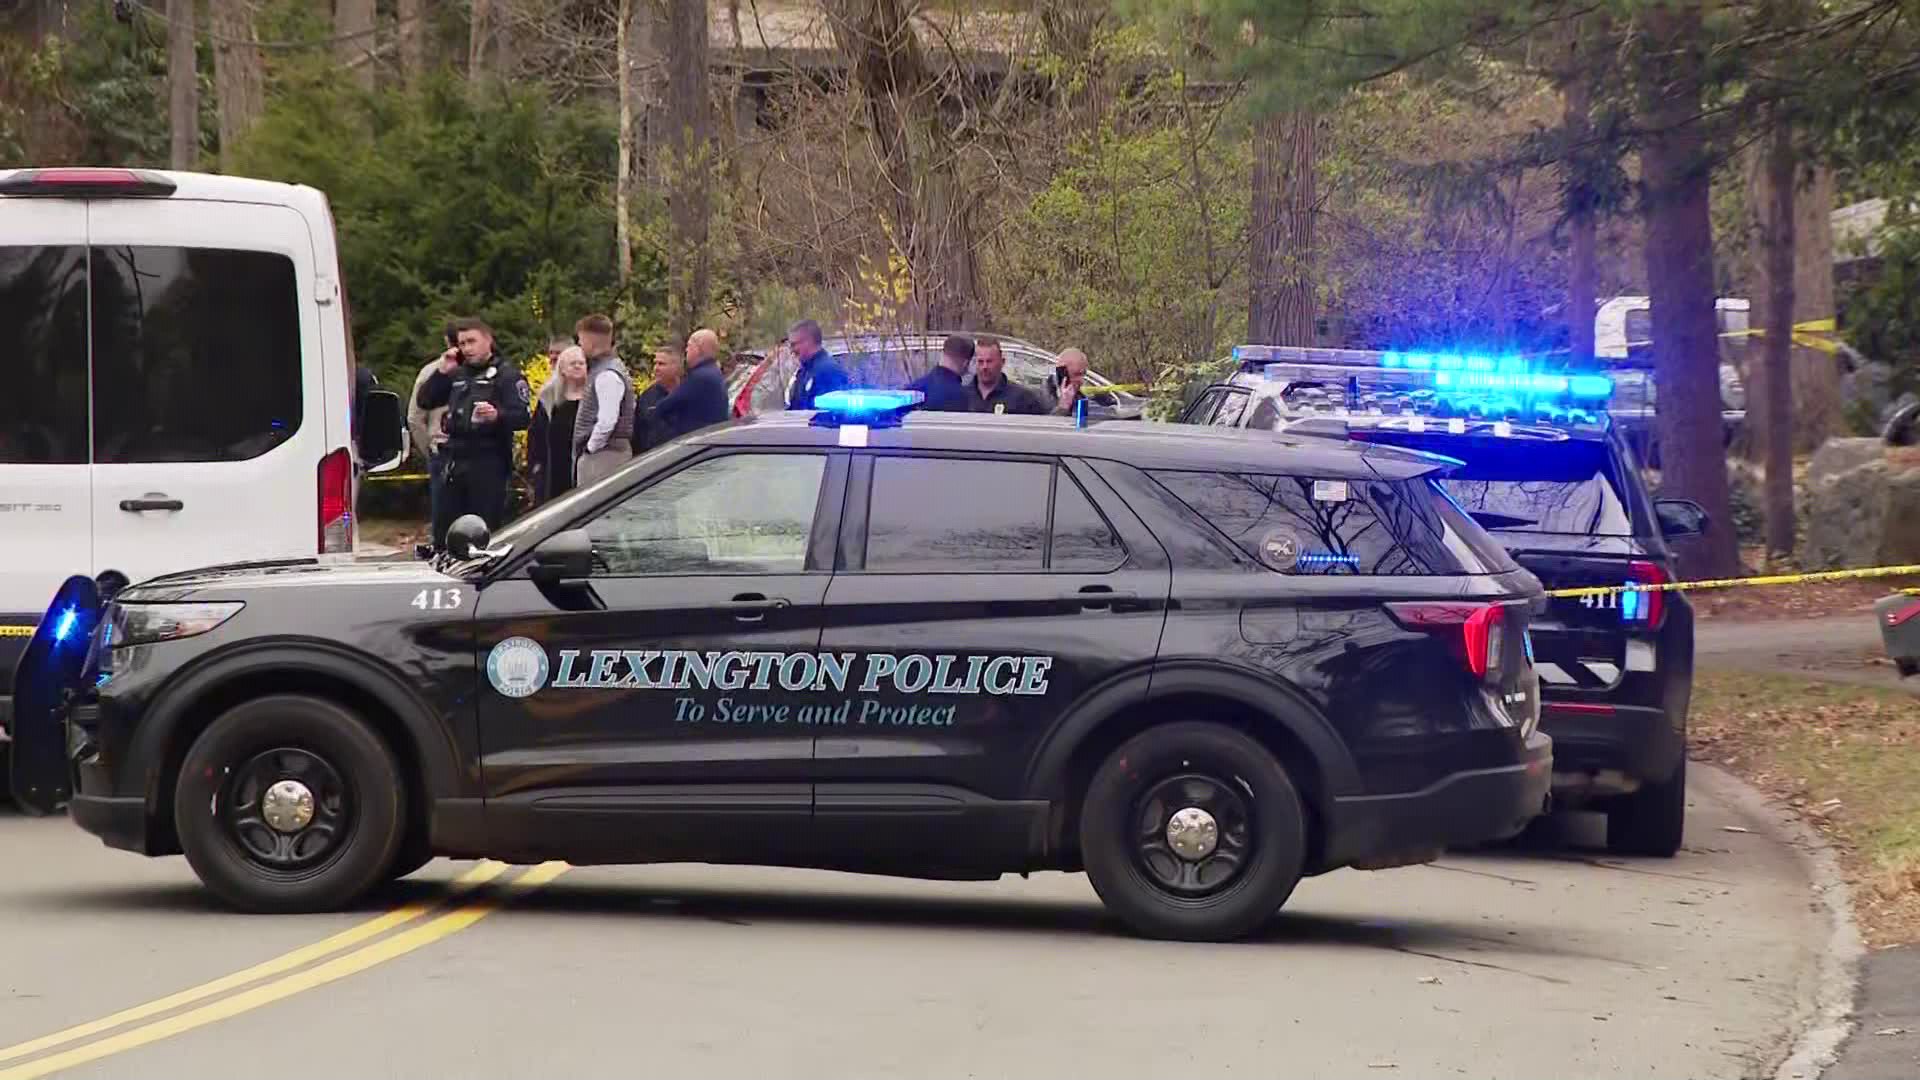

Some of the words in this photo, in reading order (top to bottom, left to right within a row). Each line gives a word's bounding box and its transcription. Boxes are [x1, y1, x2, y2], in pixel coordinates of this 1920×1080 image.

[411, 588, 462, 610] 413
[1579, 591, 1617, 609] 411
[551, 649, 856, 691] LEXINGTON
[859, 653, 1053, 695] POLICE
[675, 698, 705, 722] To
[712, 698, 789, 723] Serve
[797, 699, 849, 725] and
[858, 700, 957, 726] Protect
